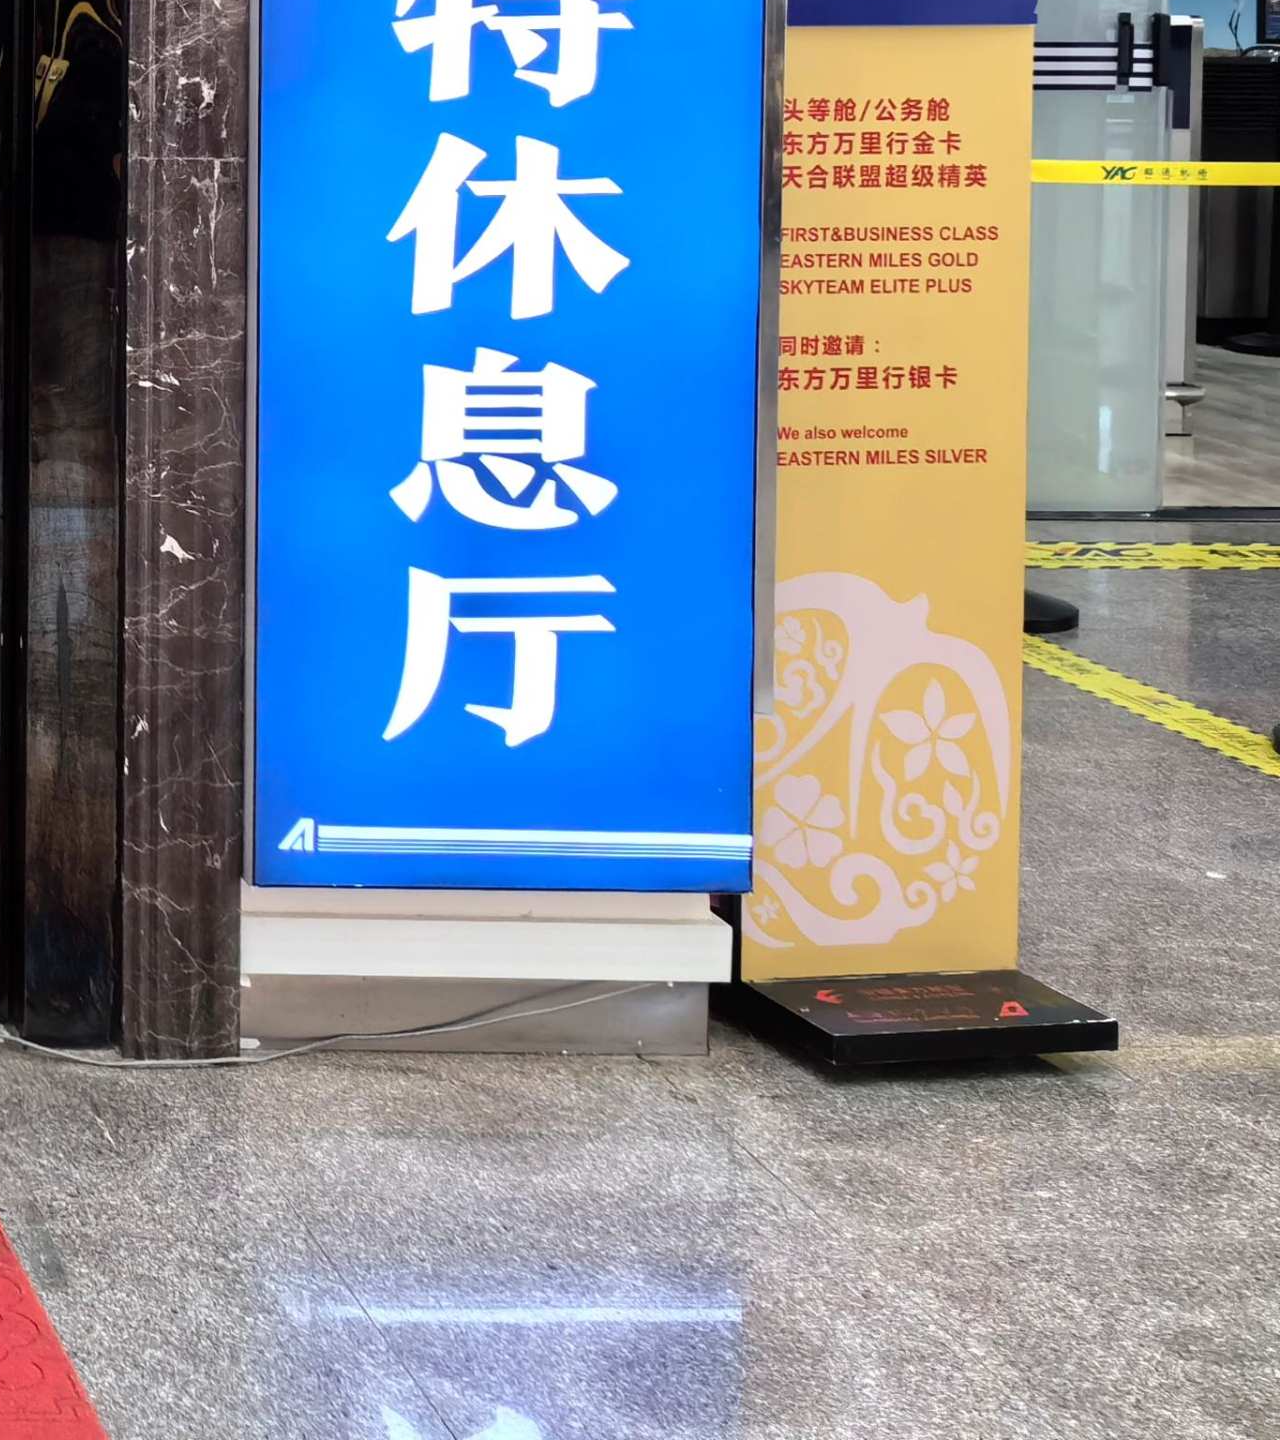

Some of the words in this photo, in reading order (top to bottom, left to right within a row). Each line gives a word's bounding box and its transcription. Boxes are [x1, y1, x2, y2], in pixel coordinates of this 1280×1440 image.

[783, 98, 950, 122] 头等舱/公务舱
[783, 131, 962, 155] 东方万里行金卡
[782, 164, 988, 188] 天合联盟超级精英
[780, 226, 934, 243] FIRST&BUSINESS
[940, 226, 999, 241] CLASS
[780, 253, 862, 269] EASTERN
[868, 252, 922, 268] MILES
[928, 252, 979, 267] GOLD
[779, 279, 864, 295] SKYTEAM
[870, 279, 920, 294] ELITE
[925, 278, 972, 293] PLUS
[778, 365, 958, 390] 东方万里行银卡
[777, 427, 800, 440] We
[804, 426, 837, 440] also
[841, 425, 908, 439] welcome
[777, 451, 860, 466] EASTERN
[866, 450, 920, 465] MILES
[925, 449, 988, 464] SILVER
